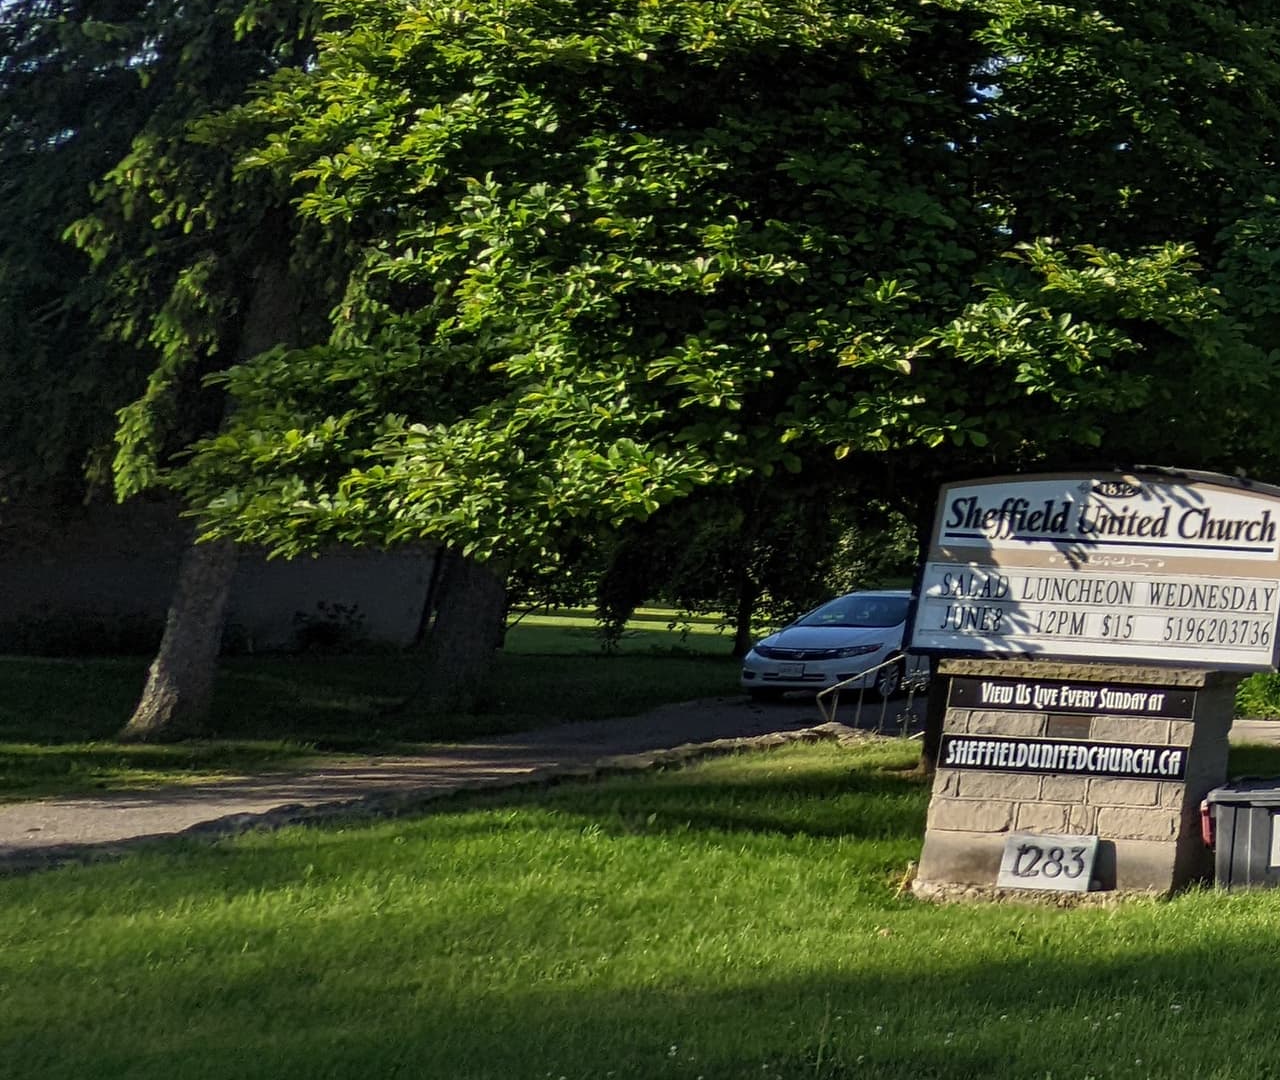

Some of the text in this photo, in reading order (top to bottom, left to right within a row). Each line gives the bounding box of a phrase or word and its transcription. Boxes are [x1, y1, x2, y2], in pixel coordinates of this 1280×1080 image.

[946, 496, 1277, 543] Sheffield United Church
[941, 573, 1275, 611] SALAD LUNCHEON WEDNESDAY
[1037, 610, 1088, 636] 12PM
[1102, 614, 1133, 638] $15
[1164, 618, 1271, 645] 5196203736
[946, 740, 1182, 775] SHEFFIELDUNITEDCHURCH.CA
[1012, 843, 1086, 878] 1283
